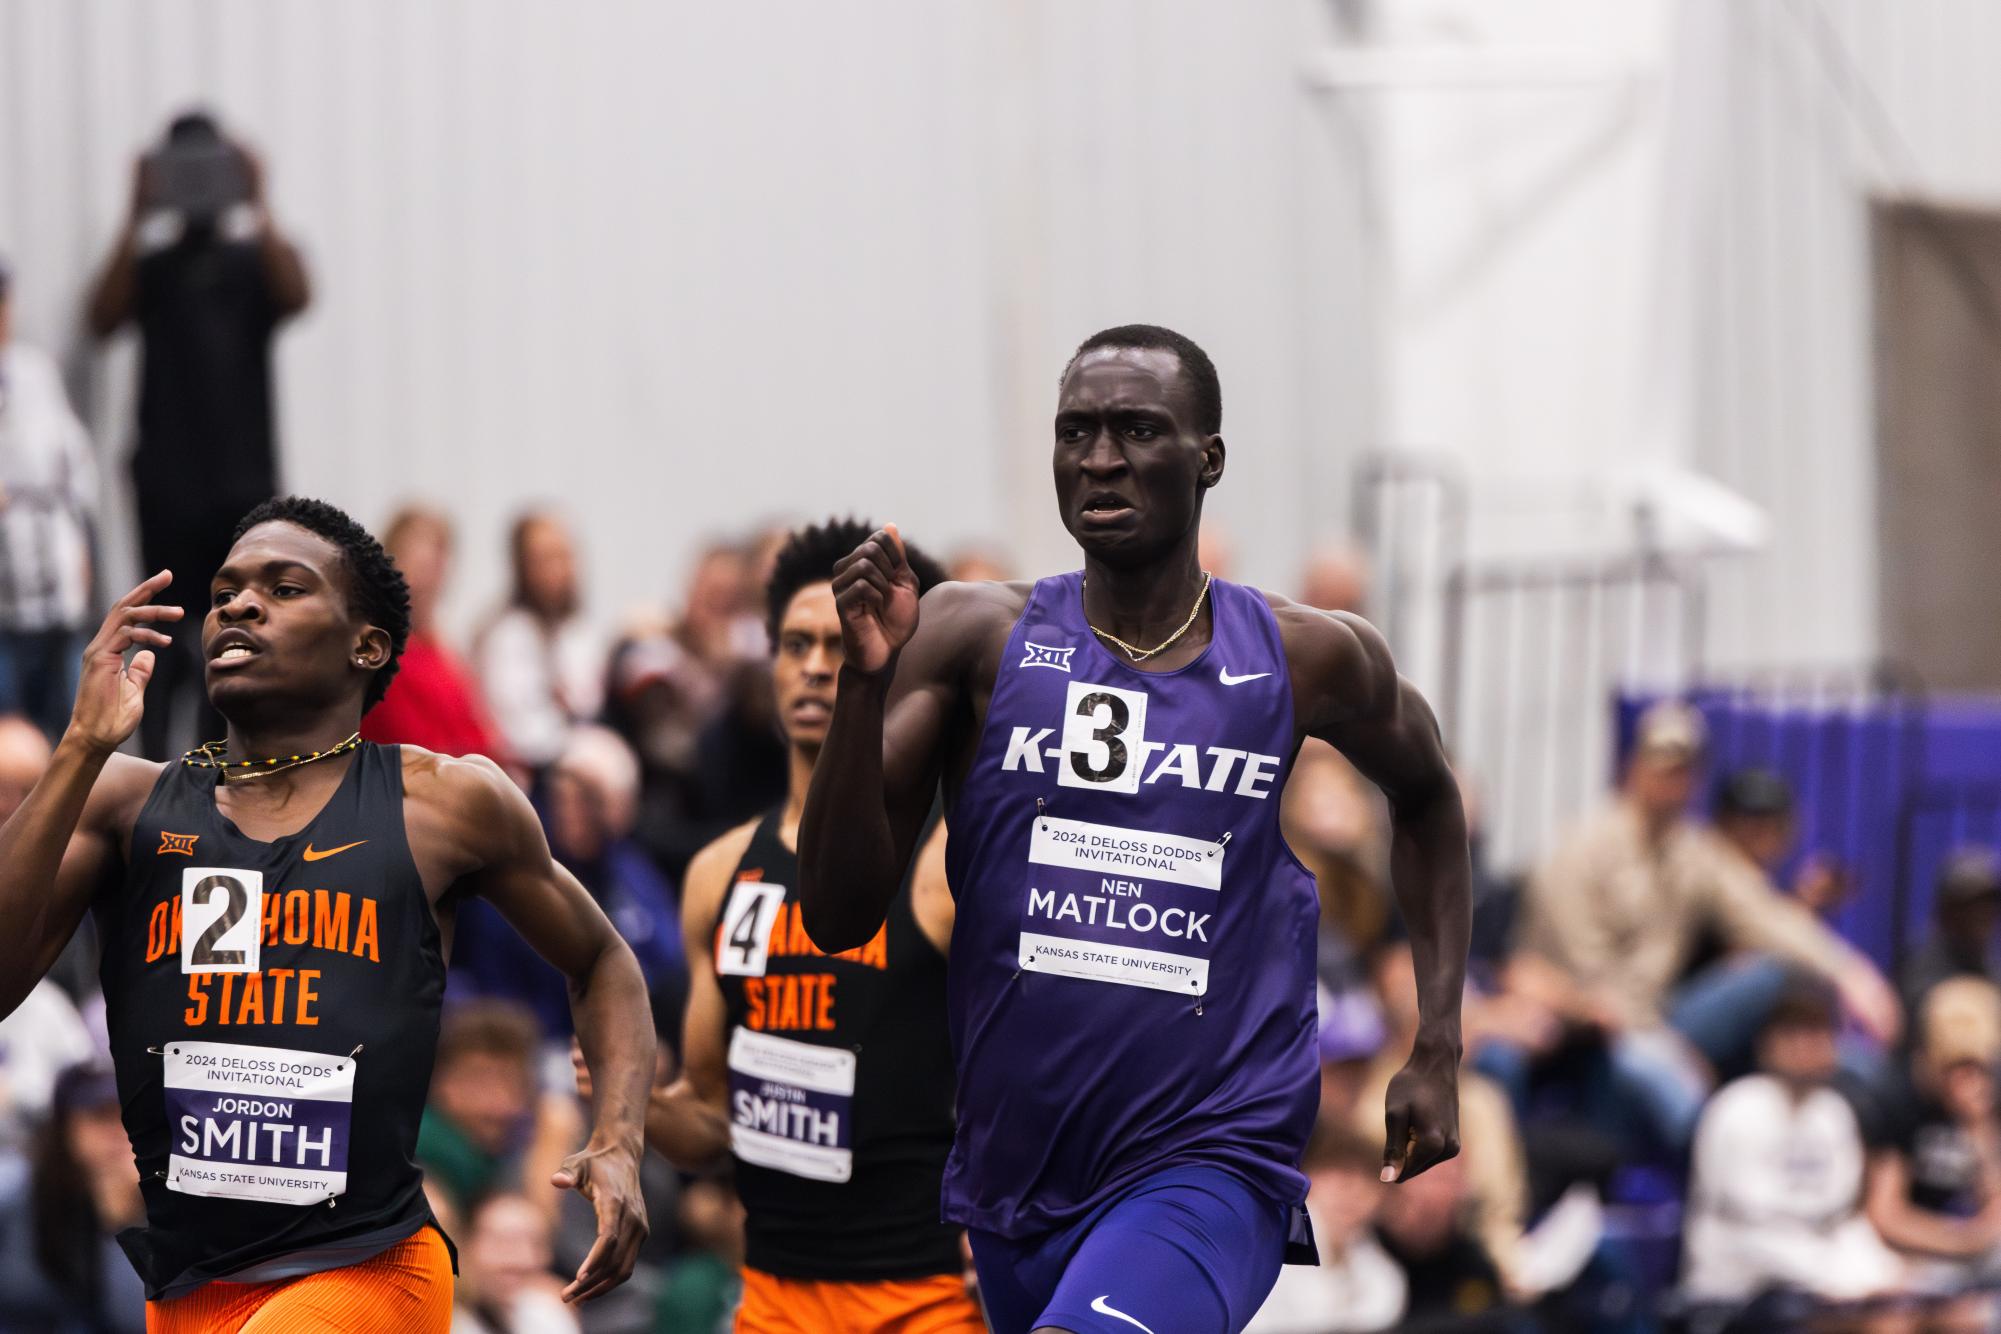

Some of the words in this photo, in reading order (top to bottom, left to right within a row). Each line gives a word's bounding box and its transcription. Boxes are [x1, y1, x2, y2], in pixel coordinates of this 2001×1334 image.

[1001, 726, 1281, 799] K-TATE
[1070, 692, 1129, 783] 3
[1052, 830, 1087, 845] 2024
[1091, 836, 1148, 853] DELOSS
[1153, 845, 1202, 862] DODDS
[1075, 847, 1177, 871] INVITATIONAL
[1101, 878, 1143, 899] NEN
[191, 875, 248, 966] 2
[729, 894, 765, 965] 4
[1027, 887, 1212, 943] MATLOCK
[1035, 945, 1079, 960] KANSAS
[1082, 952, 1118, 965] STATE
[1122, 958, 1192, 976] UNIVERSITY
[184, 968, 321, 1026] STATE
[743, 973, 837, 1031] STATE
[185, 1054, 217, 1067] 2024
[221, 1057, 276, 1072] DELOSS
[280, 1062, 332, 1078] DODDS
[207, 1070, 304, 1088] INVITATIONAL
[212, 1097, 293, 1119] JORDON
[734, 1090, 840, 1147] SMITH
[180, 1115, 332, 1167] SMITH
[179, 1167, 217, 1181] KANSAS
[220, 1173, 256, 1184] STATE
[259, 1176, 328, 1190] UNIVERSITY
